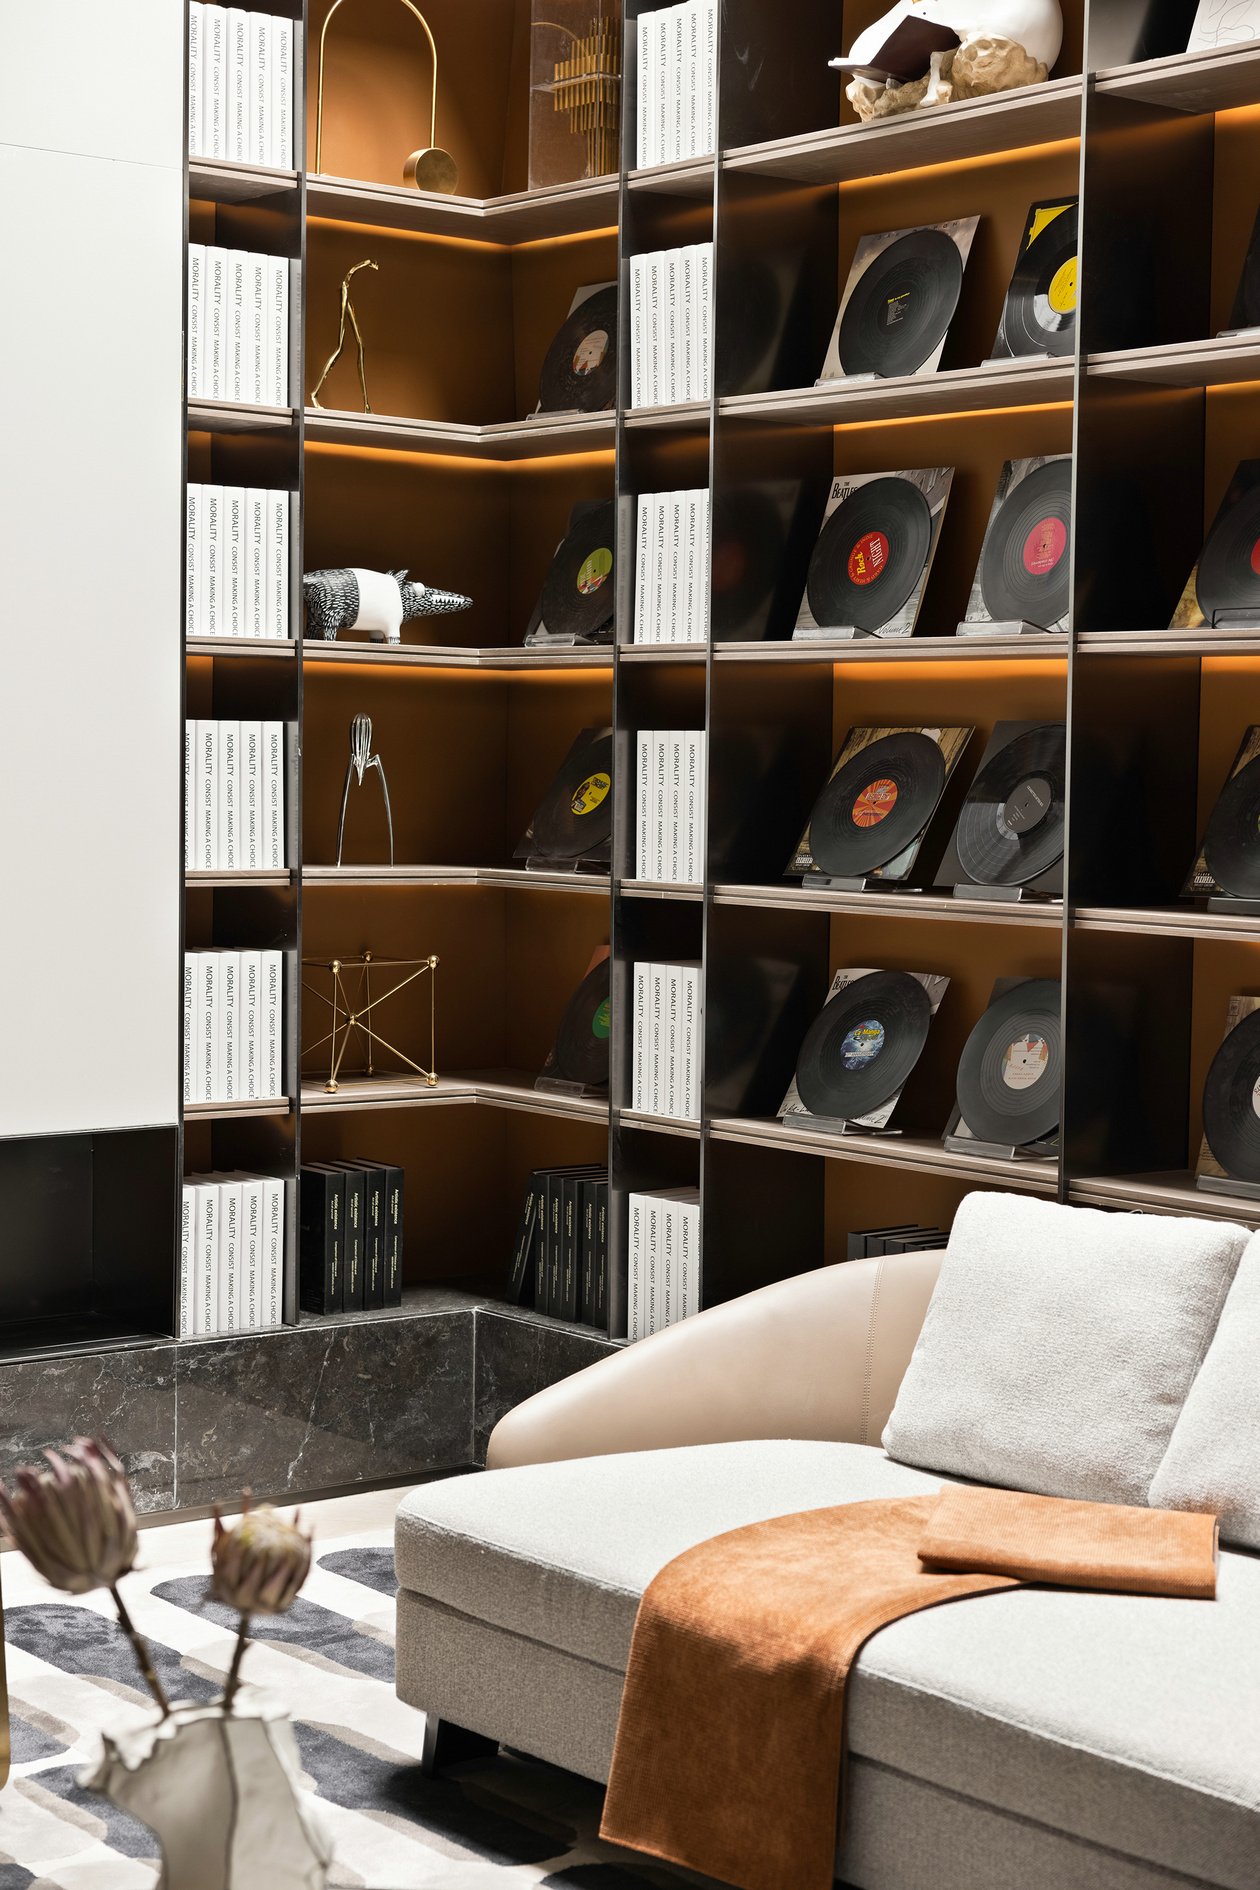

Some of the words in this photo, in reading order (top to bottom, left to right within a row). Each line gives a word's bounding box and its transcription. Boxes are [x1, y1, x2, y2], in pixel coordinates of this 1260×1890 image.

[213, 18, 221, 64] MORALITY
[236, 22, 244, 67] MORALITY
[192, 257, 200, 302] MORALITY
[235, 263, 243, 307] MORALITY
[188, 496, 196, 540] MORALITY
[210, 498, 218, 542] MORALITY
[205, 733, 213, 776] MORALITY
[248, 734, 257, 776] MORALITY
[248, 779, 256, 807] CONSIST
[205, 966, 214, 1008] MORALITY
[226, 966, 234, 1008] MORALITY
[205, 1199, 214, 1241] MORALITY
[271, 1194, 279, 1235] MORALITY
